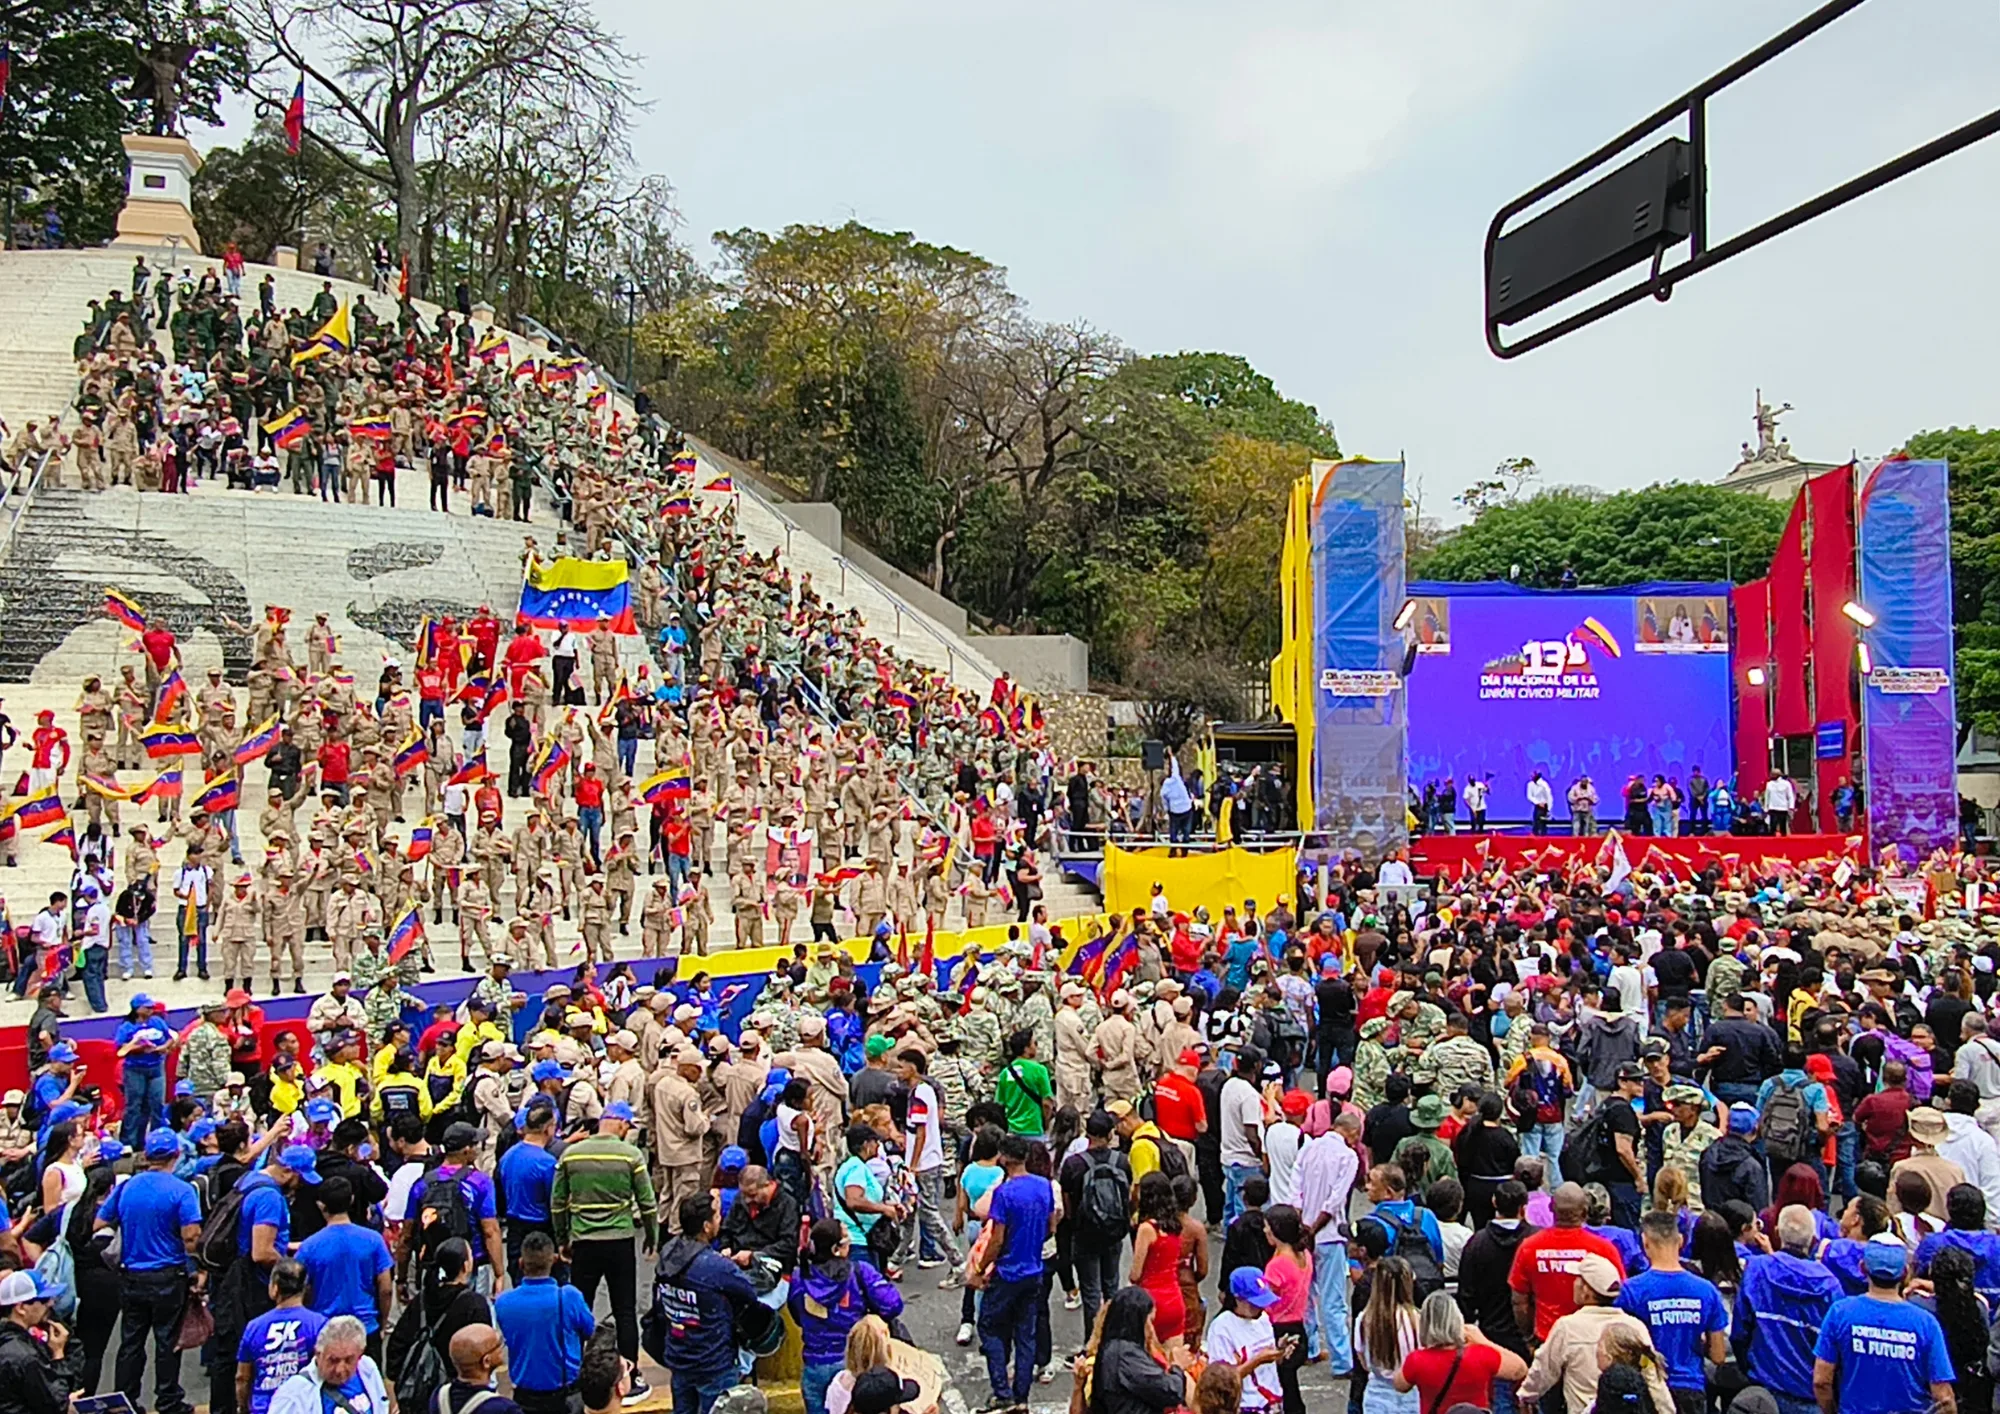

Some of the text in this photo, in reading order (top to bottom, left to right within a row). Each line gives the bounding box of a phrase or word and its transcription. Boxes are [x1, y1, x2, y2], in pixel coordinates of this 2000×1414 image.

[1503, 675, 1561, 686] NACIONAL
[1563, 675, 1579, 686] DE
[1581, 675, 1597, 686] LA
[1555, 687, 1600, 699] MILITAR
[1662, 1310, 1701, 1325] FUTURO
[264, 1320, 302, 1351] 5K
[1852, 1337, 1916, 1360] EL FUTURO
